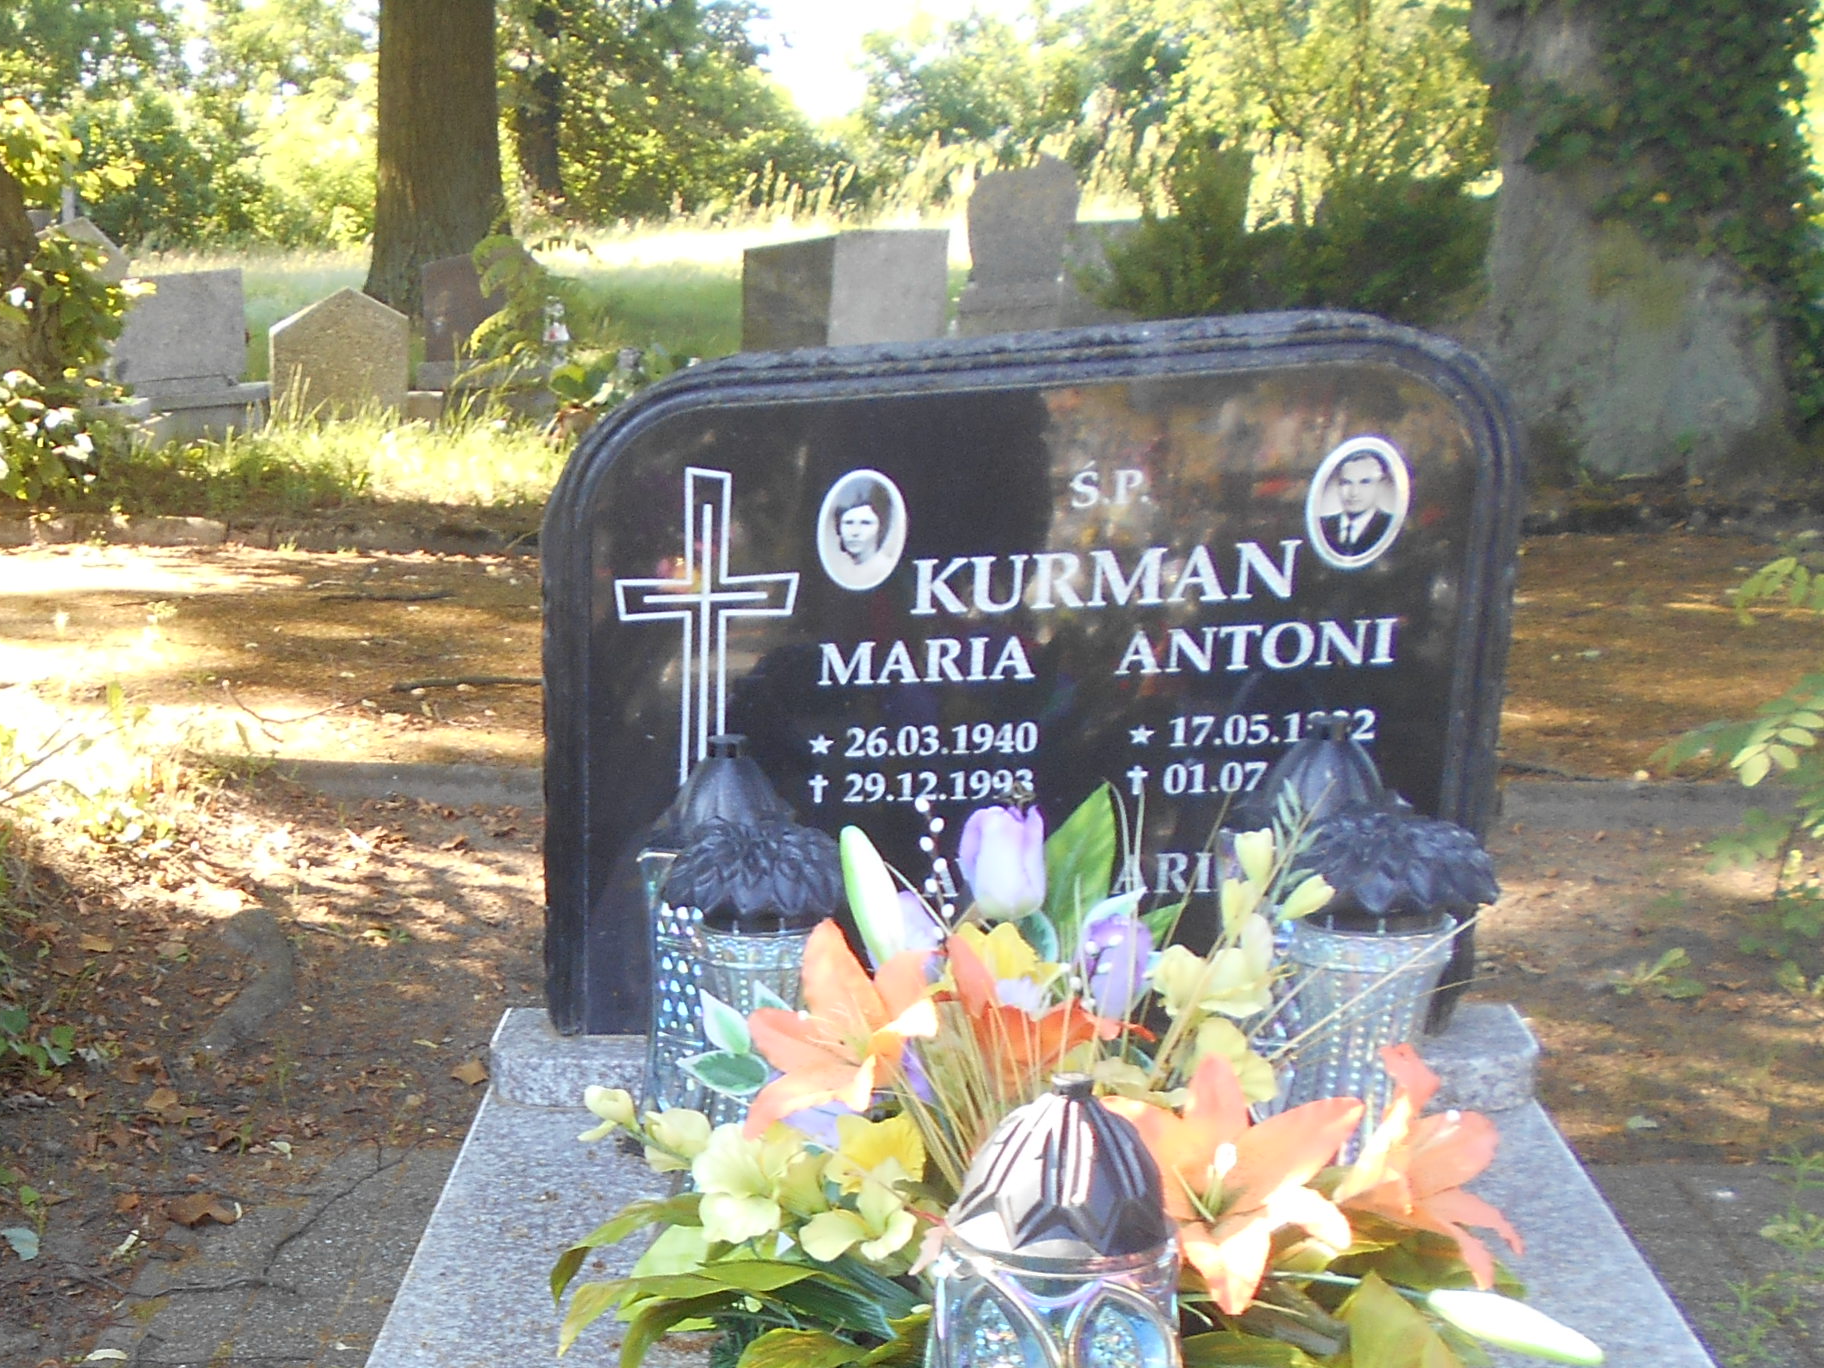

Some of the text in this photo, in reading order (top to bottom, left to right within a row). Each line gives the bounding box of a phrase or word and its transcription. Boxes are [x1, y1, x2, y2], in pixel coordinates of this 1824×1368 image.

[1069, 461, 1152, 509] Ś.P.
[909, 539, 1303, 617] KURMAN
[817, 635, 1035, 686] MARIA
[1114, 616, 1399, 678] ANTONI
[843, 720, 1039, 758] 26.03.1940
[1168, 708, 1377, 748] 17.05.12
